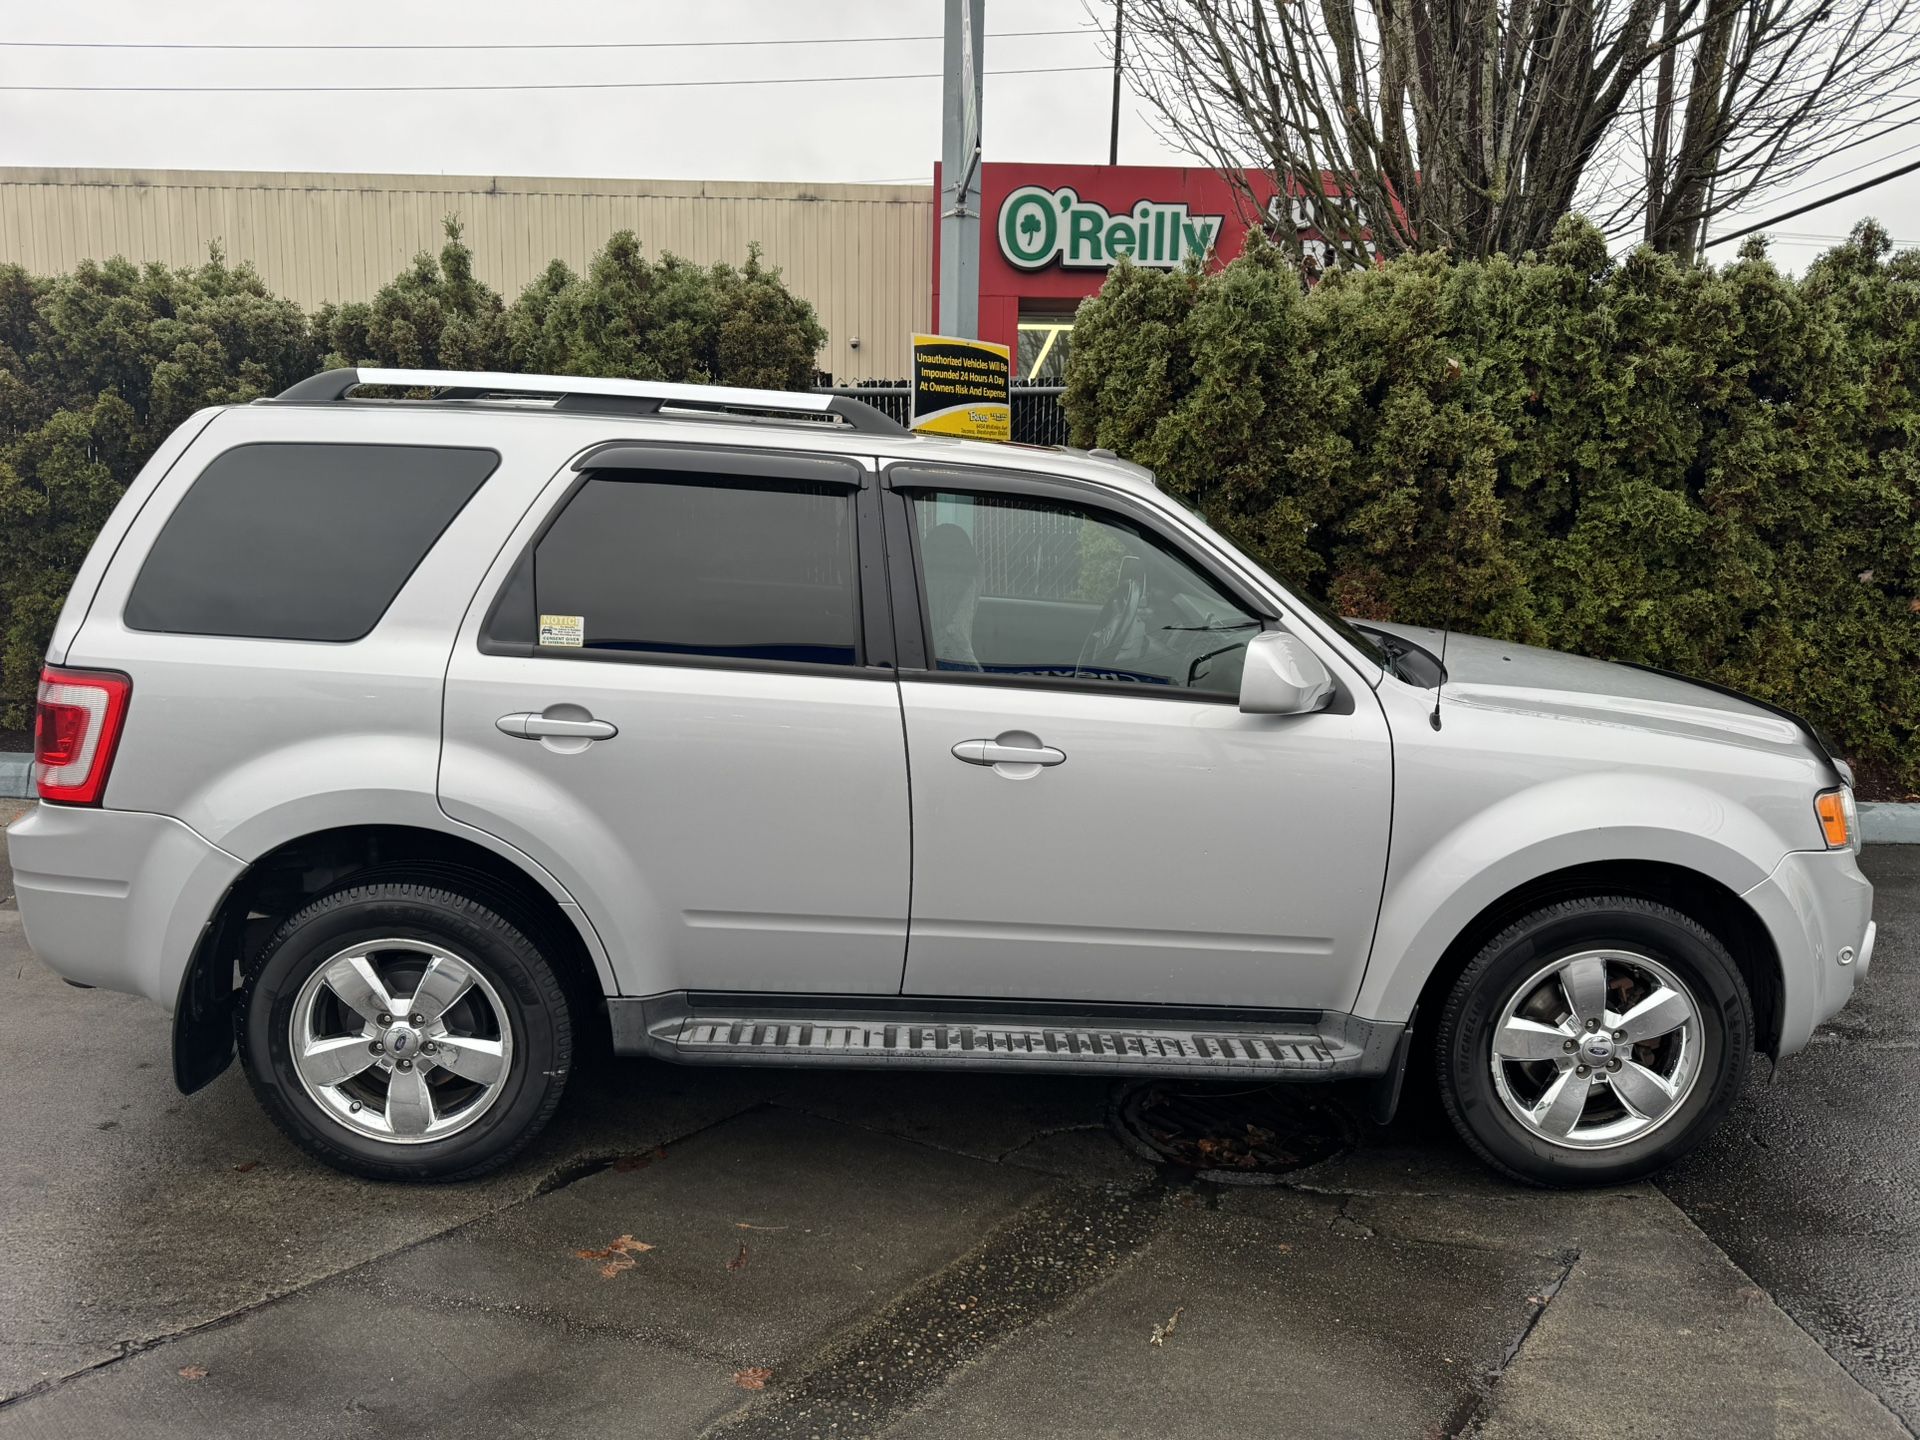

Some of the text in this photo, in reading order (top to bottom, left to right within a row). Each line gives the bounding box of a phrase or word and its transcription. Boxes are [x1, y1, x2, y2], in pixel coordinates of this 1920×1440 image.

[1005, 194, 1214, 261] O'Reilly
[917, 353, 1008, 372] Unauthorized Vehicles Will Be
[921, 367, 1005, 386] Impounded 24 Hours A Day
[919, 381, 1007, 399] At Owners Risk And Expense
[1460, 999, 1482, 1075] MICHELIN
[1719, 1032, 1742, 1106] MICHELIN
